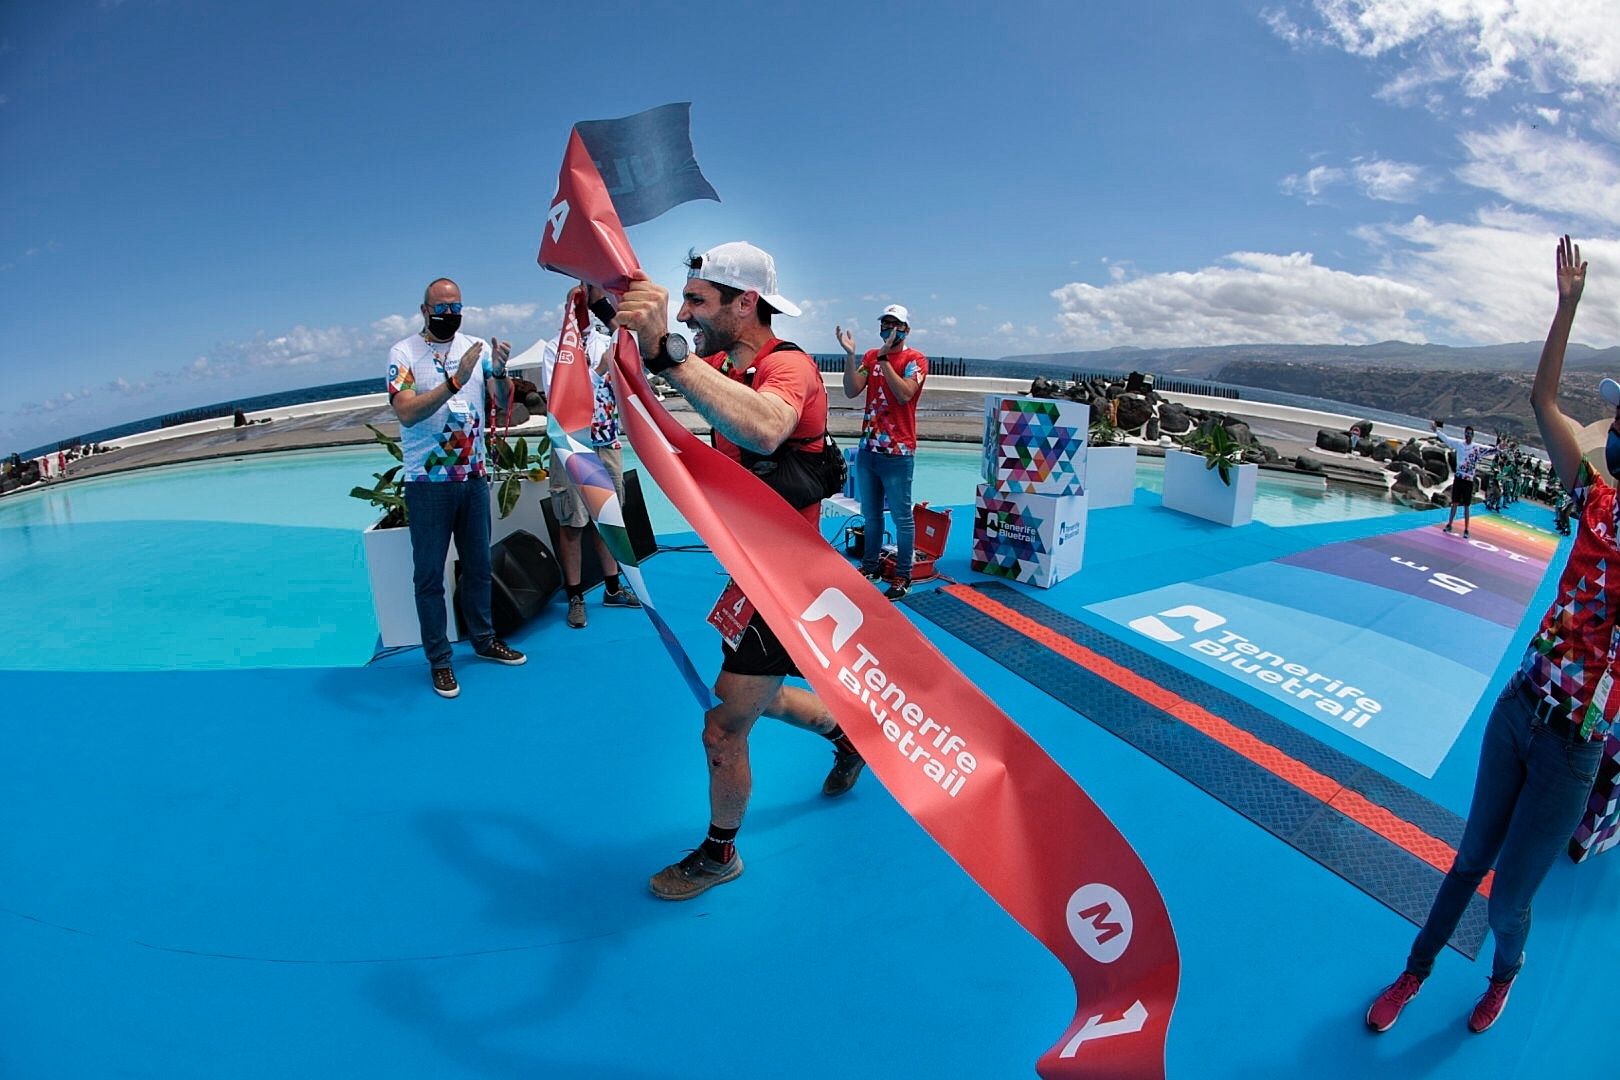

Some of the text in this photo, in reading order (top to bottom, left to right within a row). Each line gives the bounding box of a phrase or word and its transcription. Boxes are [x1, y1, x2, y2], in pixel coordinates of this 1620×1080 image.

[999, 529, 1036, 543] Bluetrail
[1000, 521, 1036, 535] Tenerife
[851, 643, 977, 774] Tenerife
[1189, 639, 1372, 729] Bluetrail
[1217, 630, 1382, 714] Tenerife
[837, 666, 966, 798] Bluetrail
[1078, 901, 1124, 945] M
